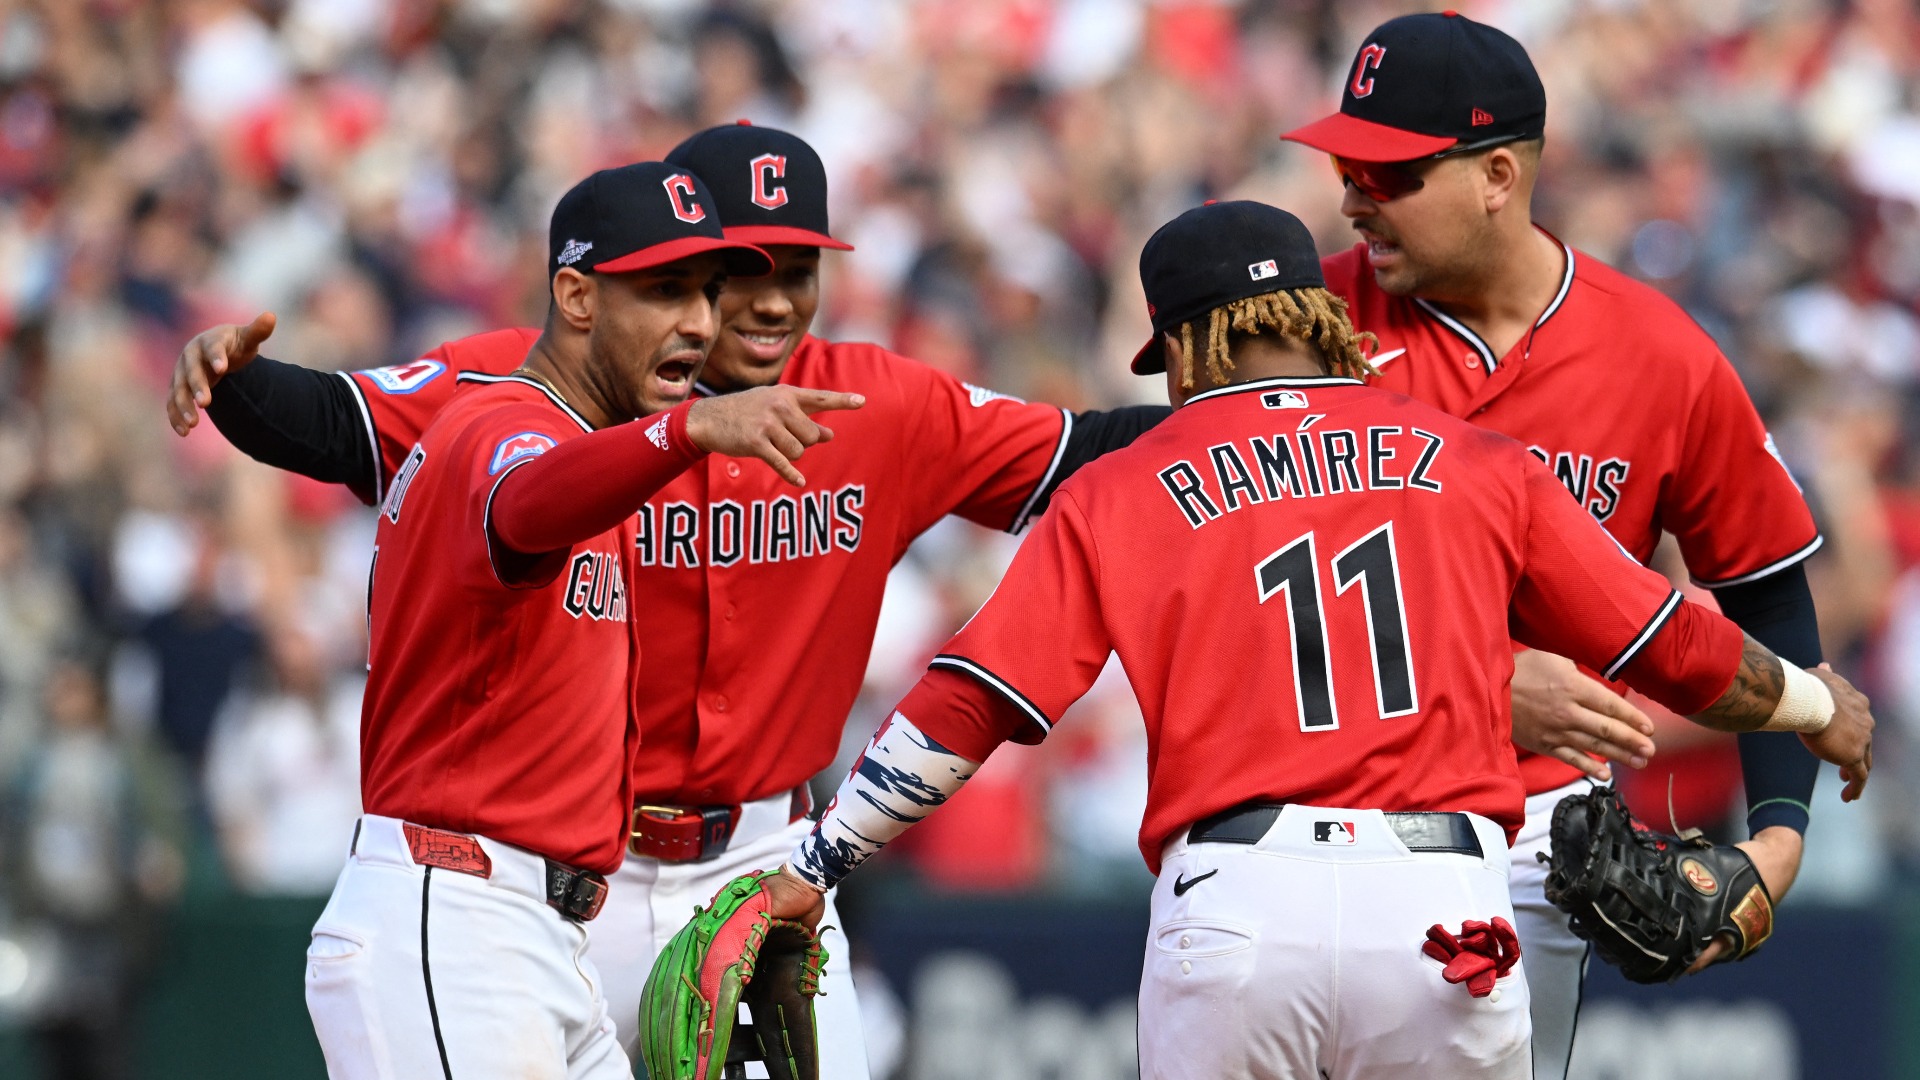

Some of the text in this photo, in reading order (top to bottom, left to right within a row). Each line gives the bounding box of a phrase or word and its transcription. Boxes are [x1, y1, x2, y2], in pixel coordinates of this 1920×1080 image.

[1350, 42, 1387, 99] C
[662, 173, 706, 224] C
[750, 153, 789, 211] C
[657, 412, 671, 451] adidas
[1156, 413, 1444, 530] RAMÍREZ
[1253, 519, 1420, 733] 11
